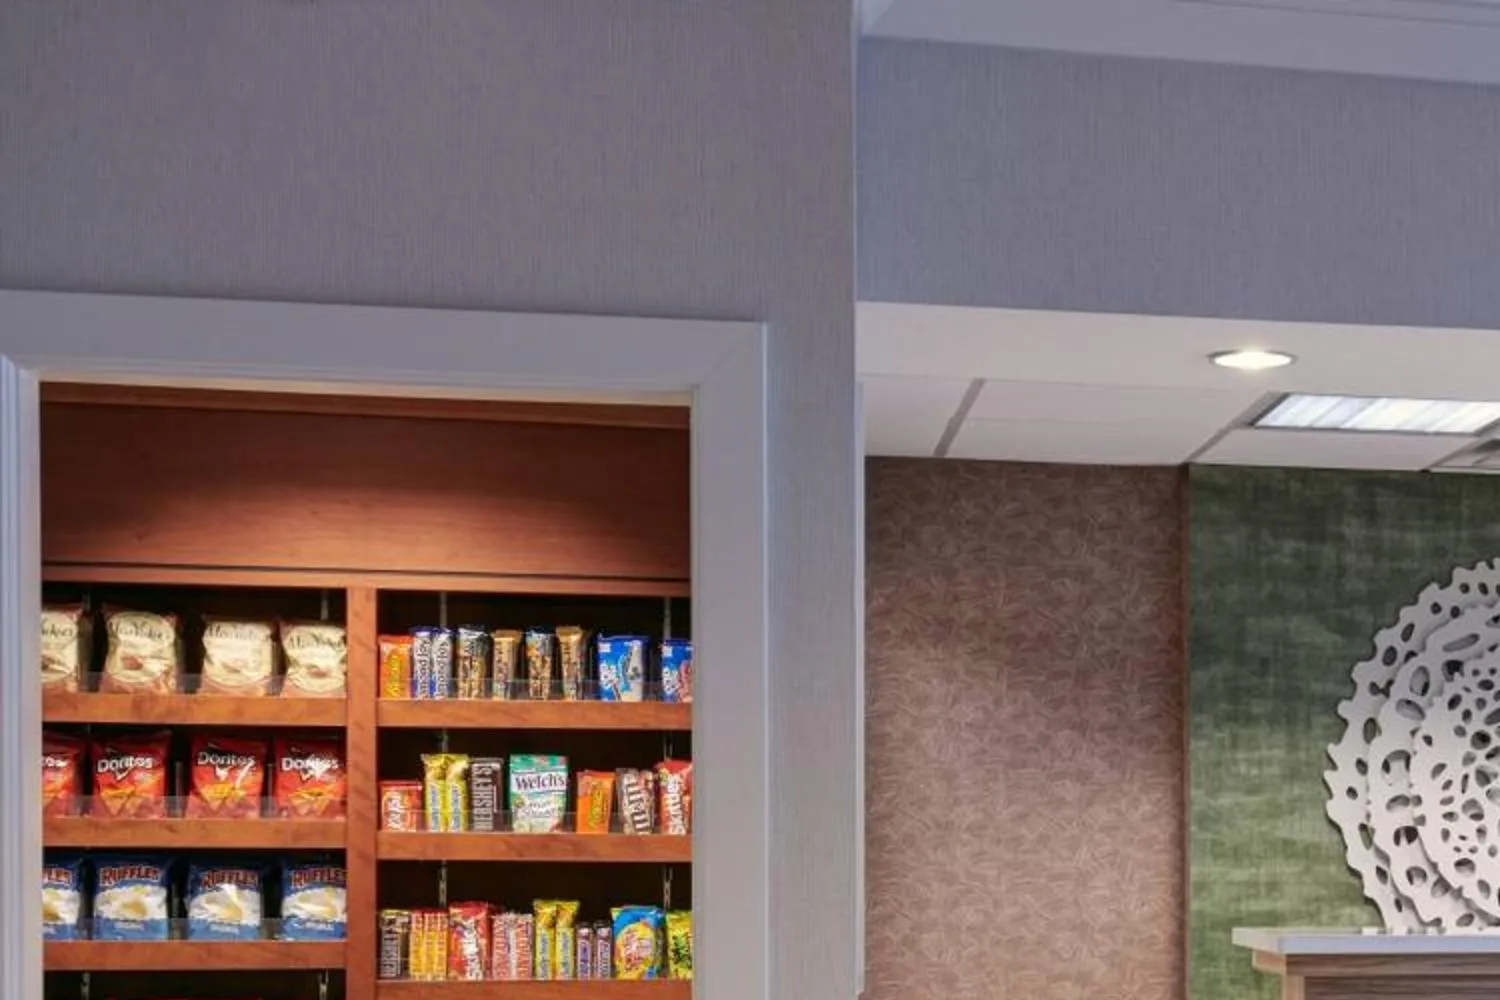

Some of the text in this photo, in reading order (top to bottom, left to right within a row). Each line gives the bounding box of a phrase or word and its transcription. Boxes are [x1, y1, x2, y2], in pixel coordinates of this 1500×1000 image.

[97, 755, 154, 773] Doritos
[197, 751, 256, 767] Doritos
[281, 755, 340, 772] Doritos
[515, 773, 566, 791] Welch's
[473, 764, 494, 831] HERSHEY'S
[101, 864, 161, 886] RUFFLES
